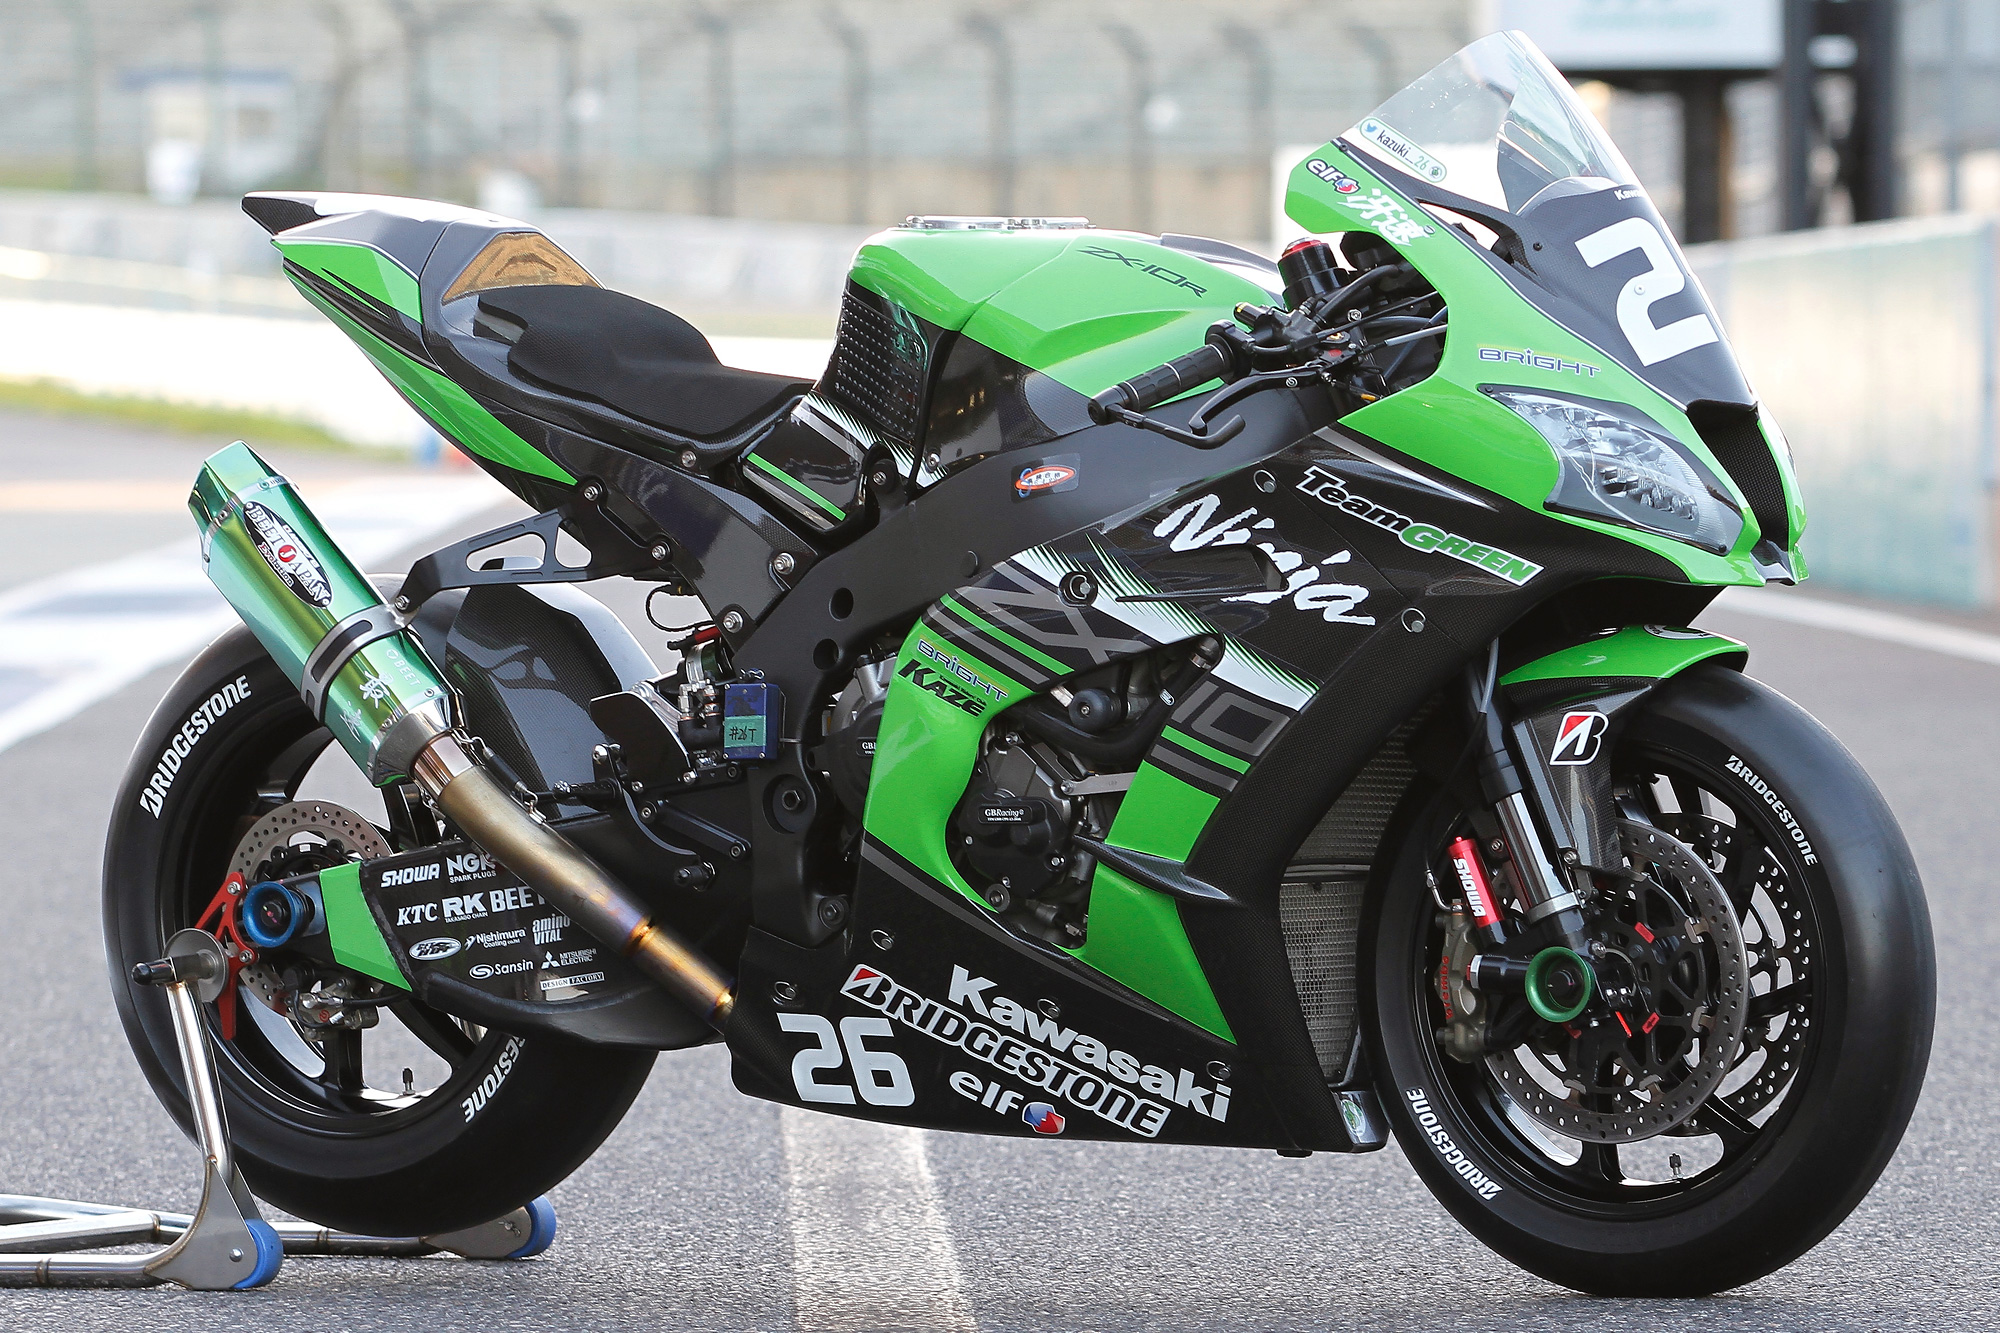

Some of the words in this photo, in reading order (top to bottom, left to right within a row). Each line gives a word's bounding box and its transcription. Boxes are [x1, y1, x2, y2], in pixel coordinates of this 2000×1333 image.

[1306, 158, 1347, 187] elf
[1076, 245, 1208, 298] ZX-10R
[1575, 217, 1720, 367] 2
[244, 504, 286, 546] BEET
[278, 544, 332, 602] JAPAN
[1152, 493, 1377, 626] Ninja
[393, 660, 421, 687] BEET
[898, 658, 987, 718] KAZE
[139, 674, 252, 820] BRIDGESTONE
[1724, 754, 1819, 866] BRIDGESTONE
[380, 863, 440, 888] SHOWA
[449, 874, 472, 884] SPARK
[473, 869, 497, 880] PLUGS
[1452, 857, 1488, 918] SHOWA
[396, 902, 438, 927] KTC
[442, 891, 488, 918] RK
[490, 885, 546, 913] BEE
[475, 927, 527, 945] Nishimura
[532, 913, 571, 934] amino
[533, 928, 562, 946] VITAL
[494, 958, 534, 976] Sansin
[560, 955, 594, 966] ELECTRIC
[541, 977, 568, 990] DESIGN
[569, 972, 605, 986] FACTORY
[776, 1012, 915, 1107] 26
[839, 963, 1172, 1138] BRIDGESTONE
[948, 964, 1232, 1123] Kawasaki
[949, 1070, 1024, 1116] elf
[1405, 1087, 1504, 1201] BRIDGESTONE
